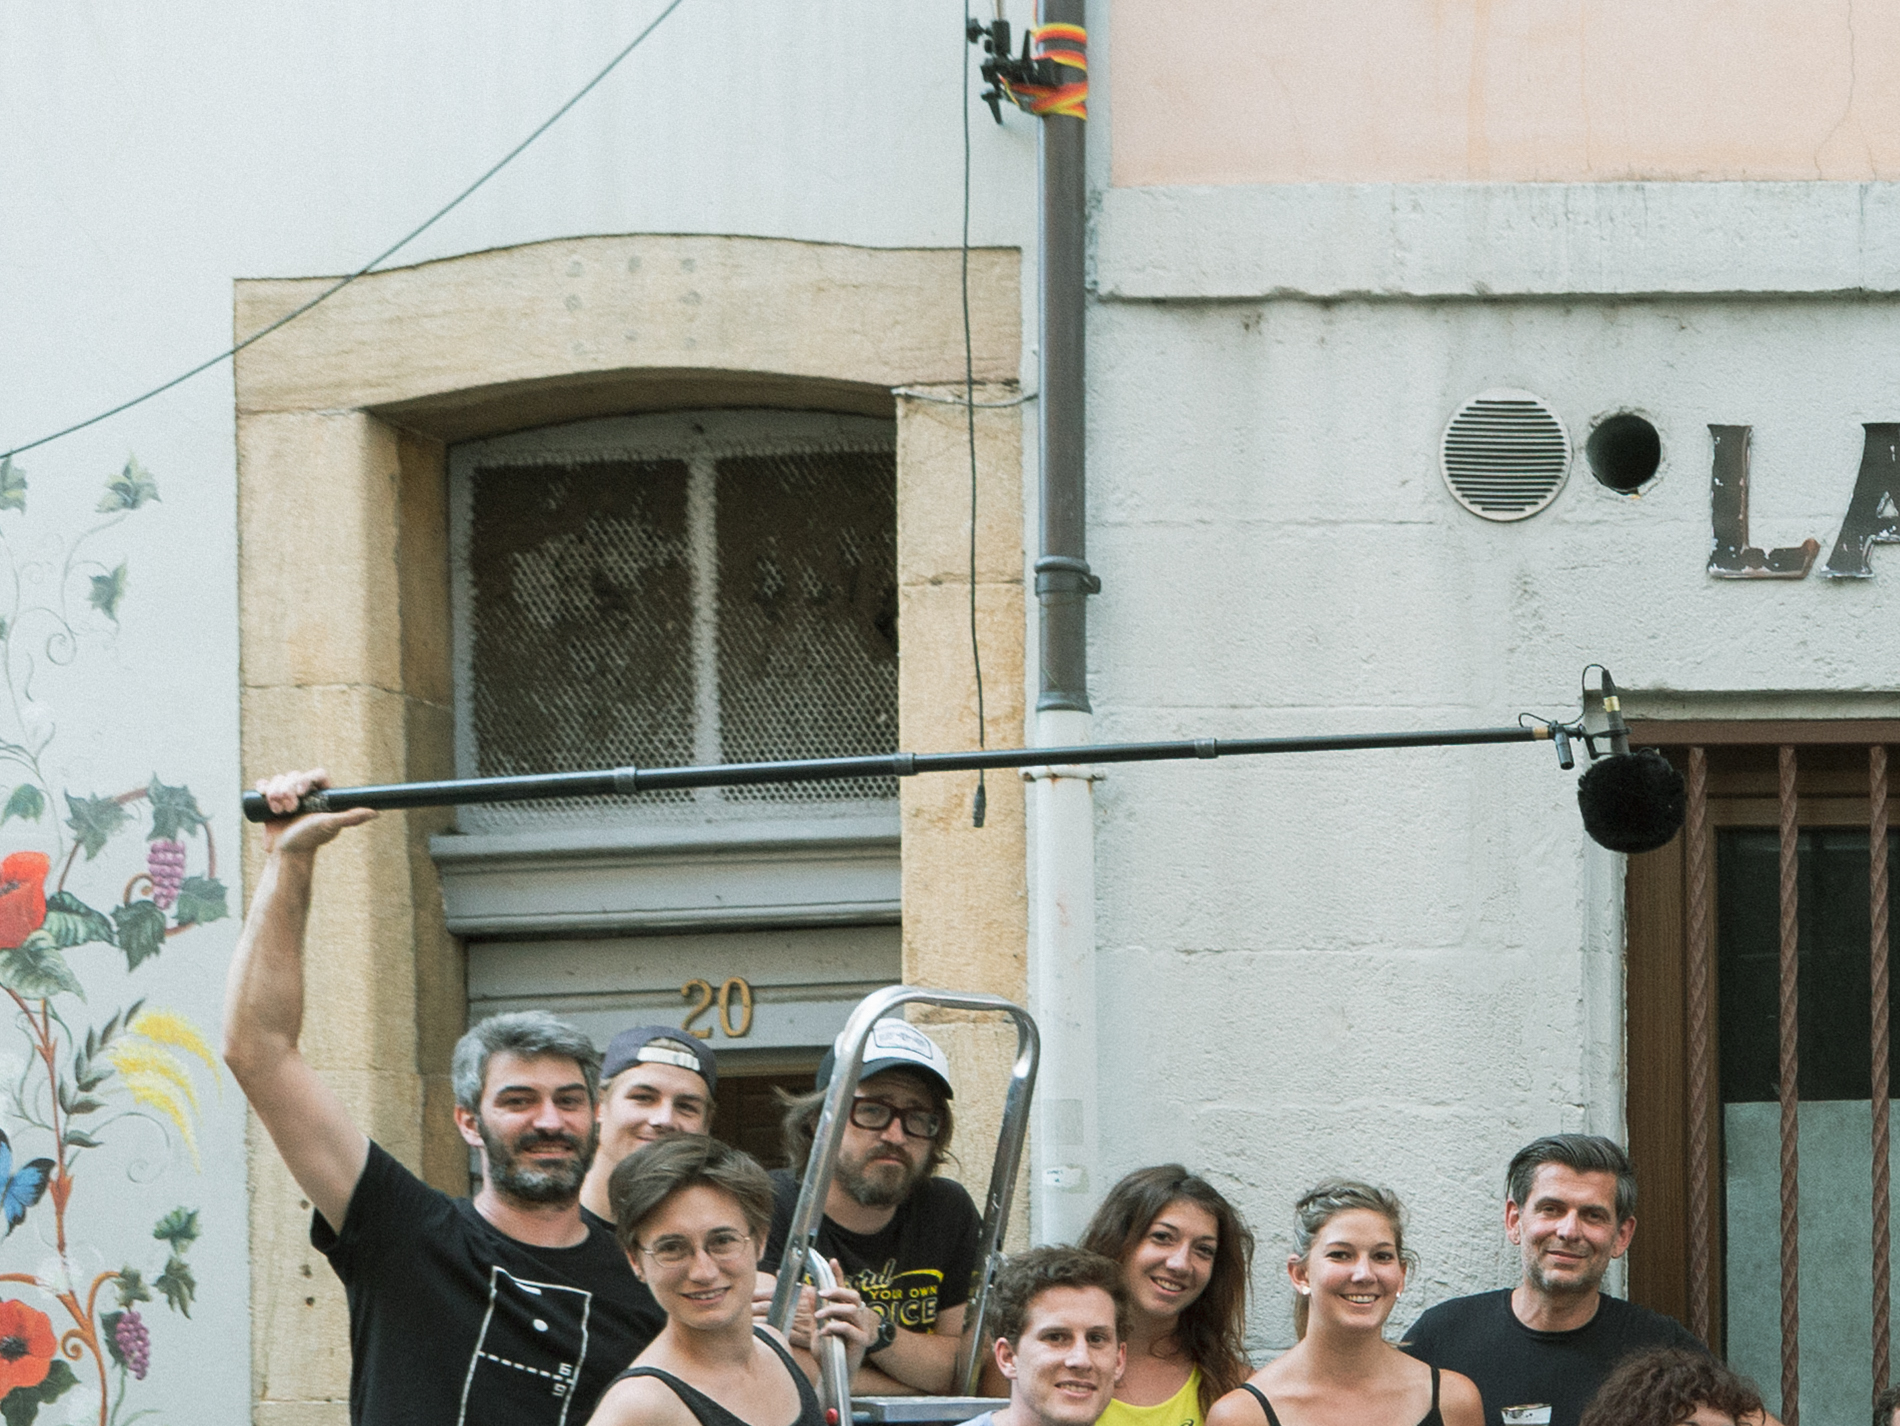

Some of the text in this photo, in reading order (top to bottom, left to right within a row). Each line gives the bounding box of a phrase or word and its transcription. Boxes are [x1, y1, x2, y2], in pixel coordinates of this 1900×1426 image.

[681, 976, 753, 1038] 20
[869, 1285, 938, 1300] YOUR OWN
